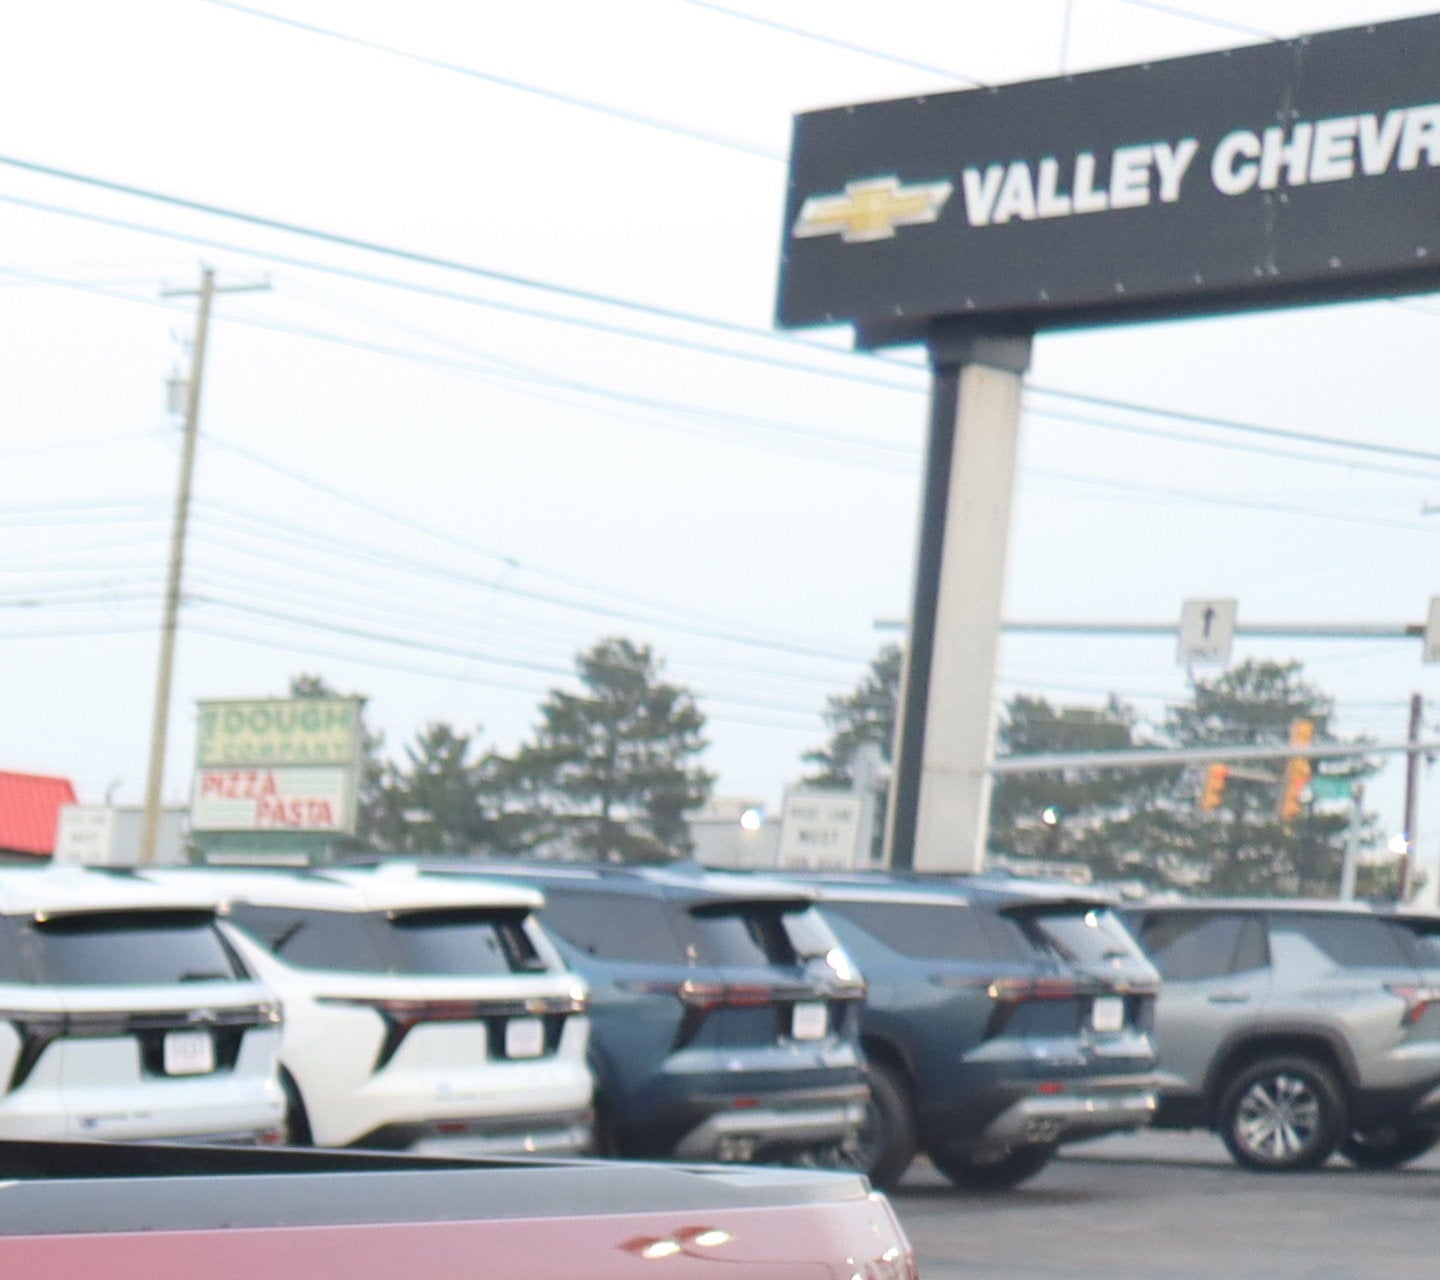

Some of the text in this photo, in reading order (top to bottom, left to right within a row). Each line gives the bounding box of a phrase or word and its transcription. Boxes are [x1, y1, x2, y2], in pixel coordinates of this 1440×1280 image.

[961, 104, 1440, 227] VALLEY CHEVR
[200, 769, 277, 799] PIZZA
[254, 798, 334, 828] PASTA
